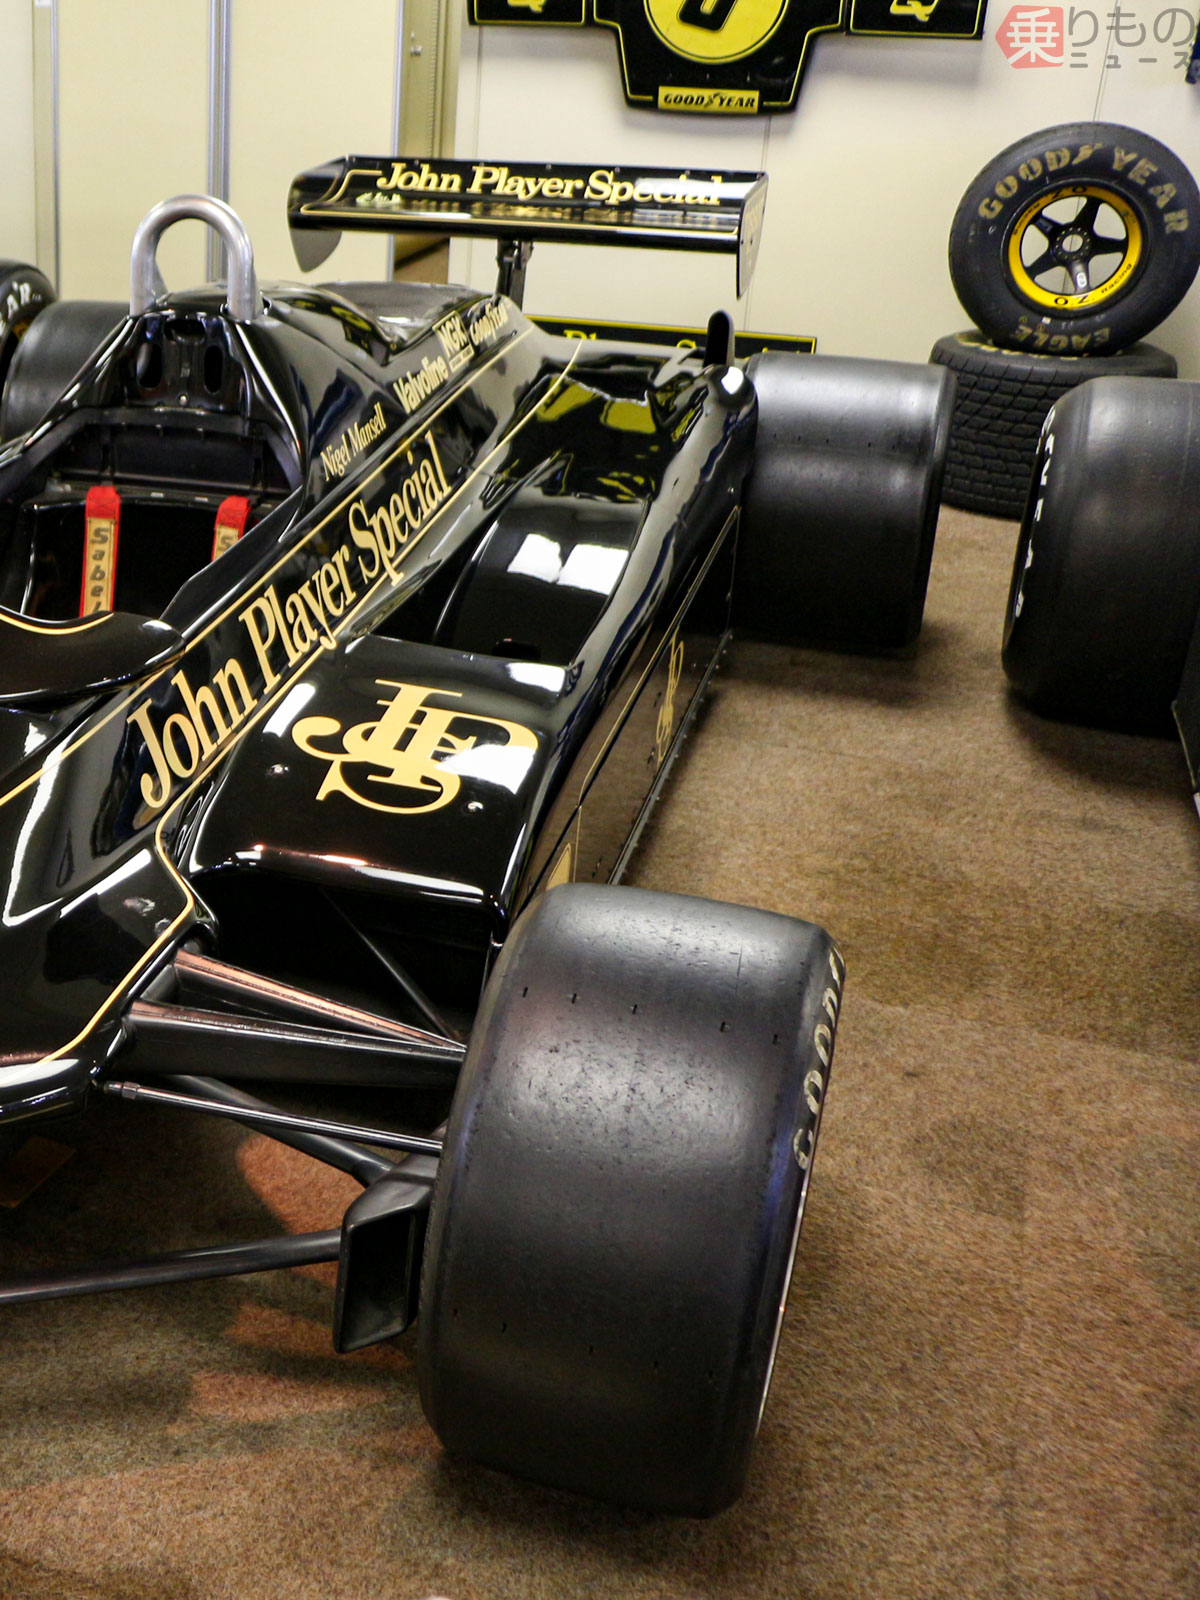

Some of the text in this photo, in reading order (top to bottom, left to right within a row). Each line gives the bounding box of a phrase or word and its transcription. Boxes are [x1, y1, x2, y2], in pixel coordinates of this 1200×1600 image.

[377, 163, 721, 206] John Player Special
[439, 314, 468, 358] NGK
[393, 355, 449, 414] Valvoline
[319, 401, 388, 482] Nigel Mansell
[126, 429, 453, 808] John Player Special
